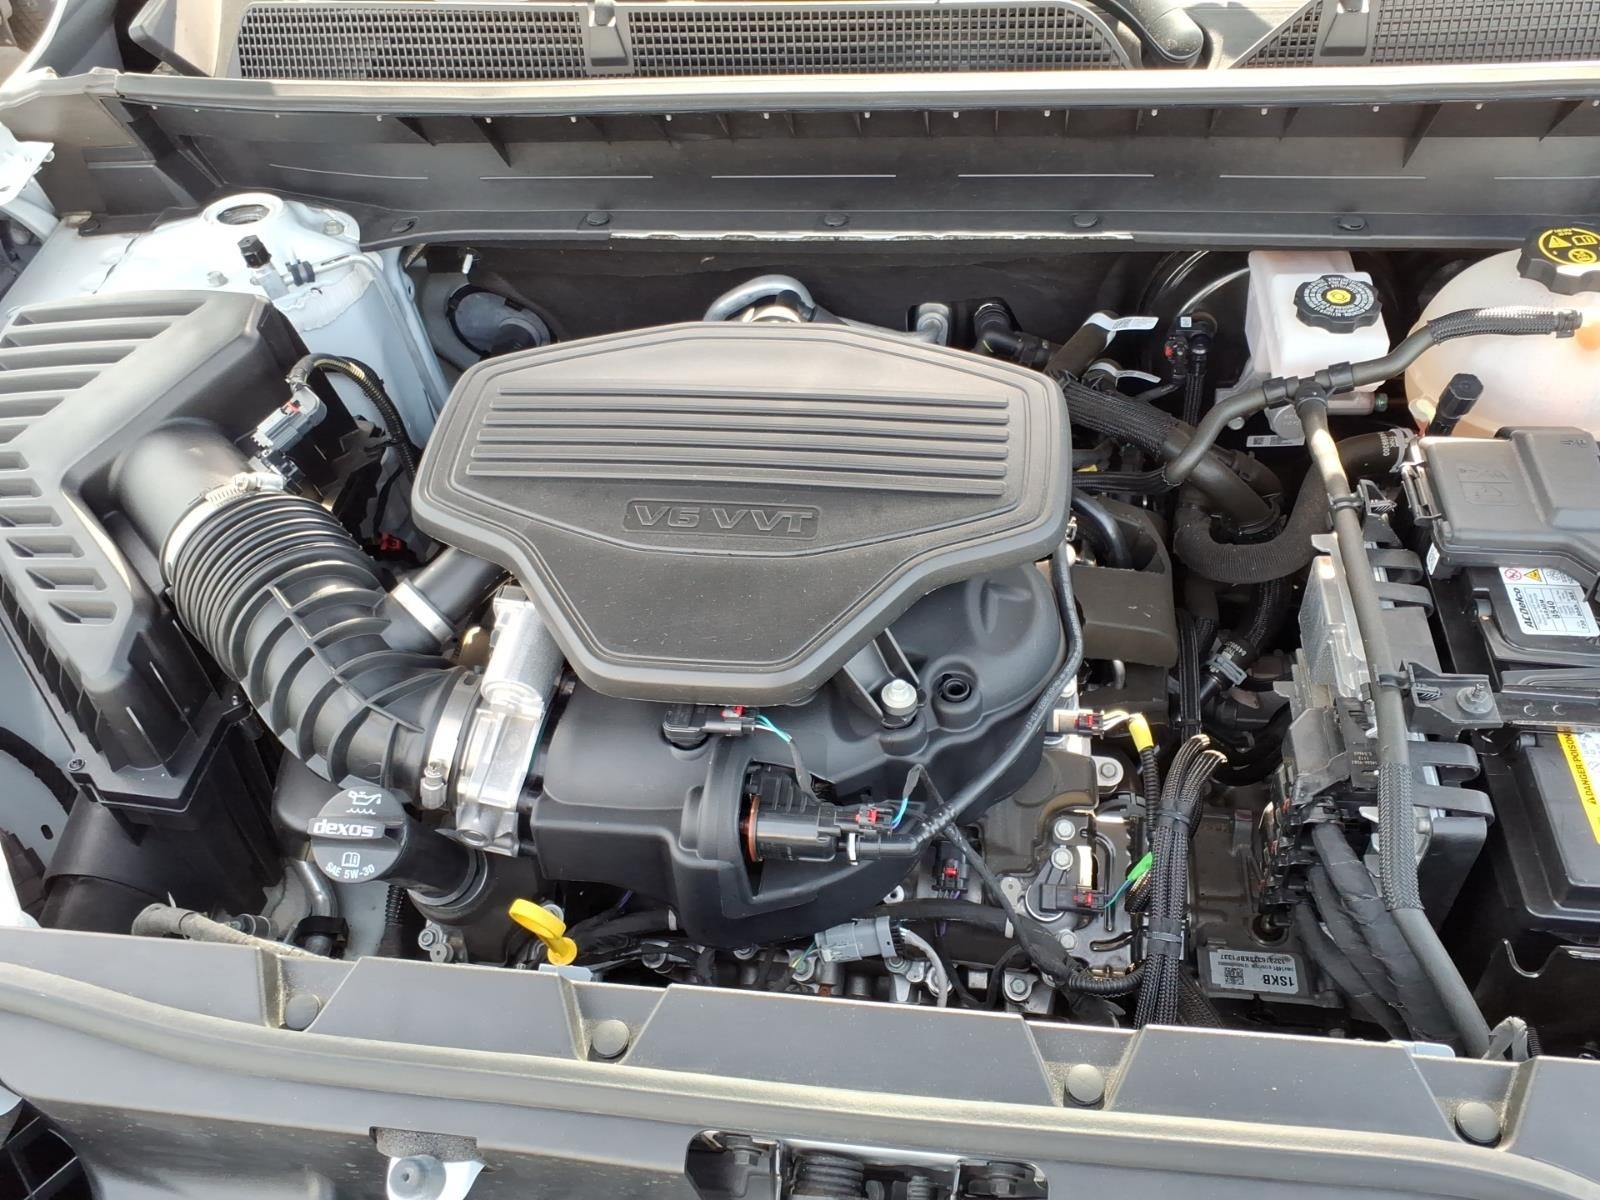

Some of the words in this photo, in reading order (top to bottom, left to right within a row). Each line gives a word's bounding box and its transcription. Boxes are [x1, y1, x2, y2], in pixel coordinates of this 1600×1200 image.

[634, 504, 700, 528] V6
[711, 507, 813, 533] VVT
[1513, 587, 1534, 628] ACDelco
[313, 819, 376, 838] dexos
[326, 861, 342, 877] SAE
[344, 863, 375, 879] 5W-30
[1262, 974, 1295, 987] 1SKB
